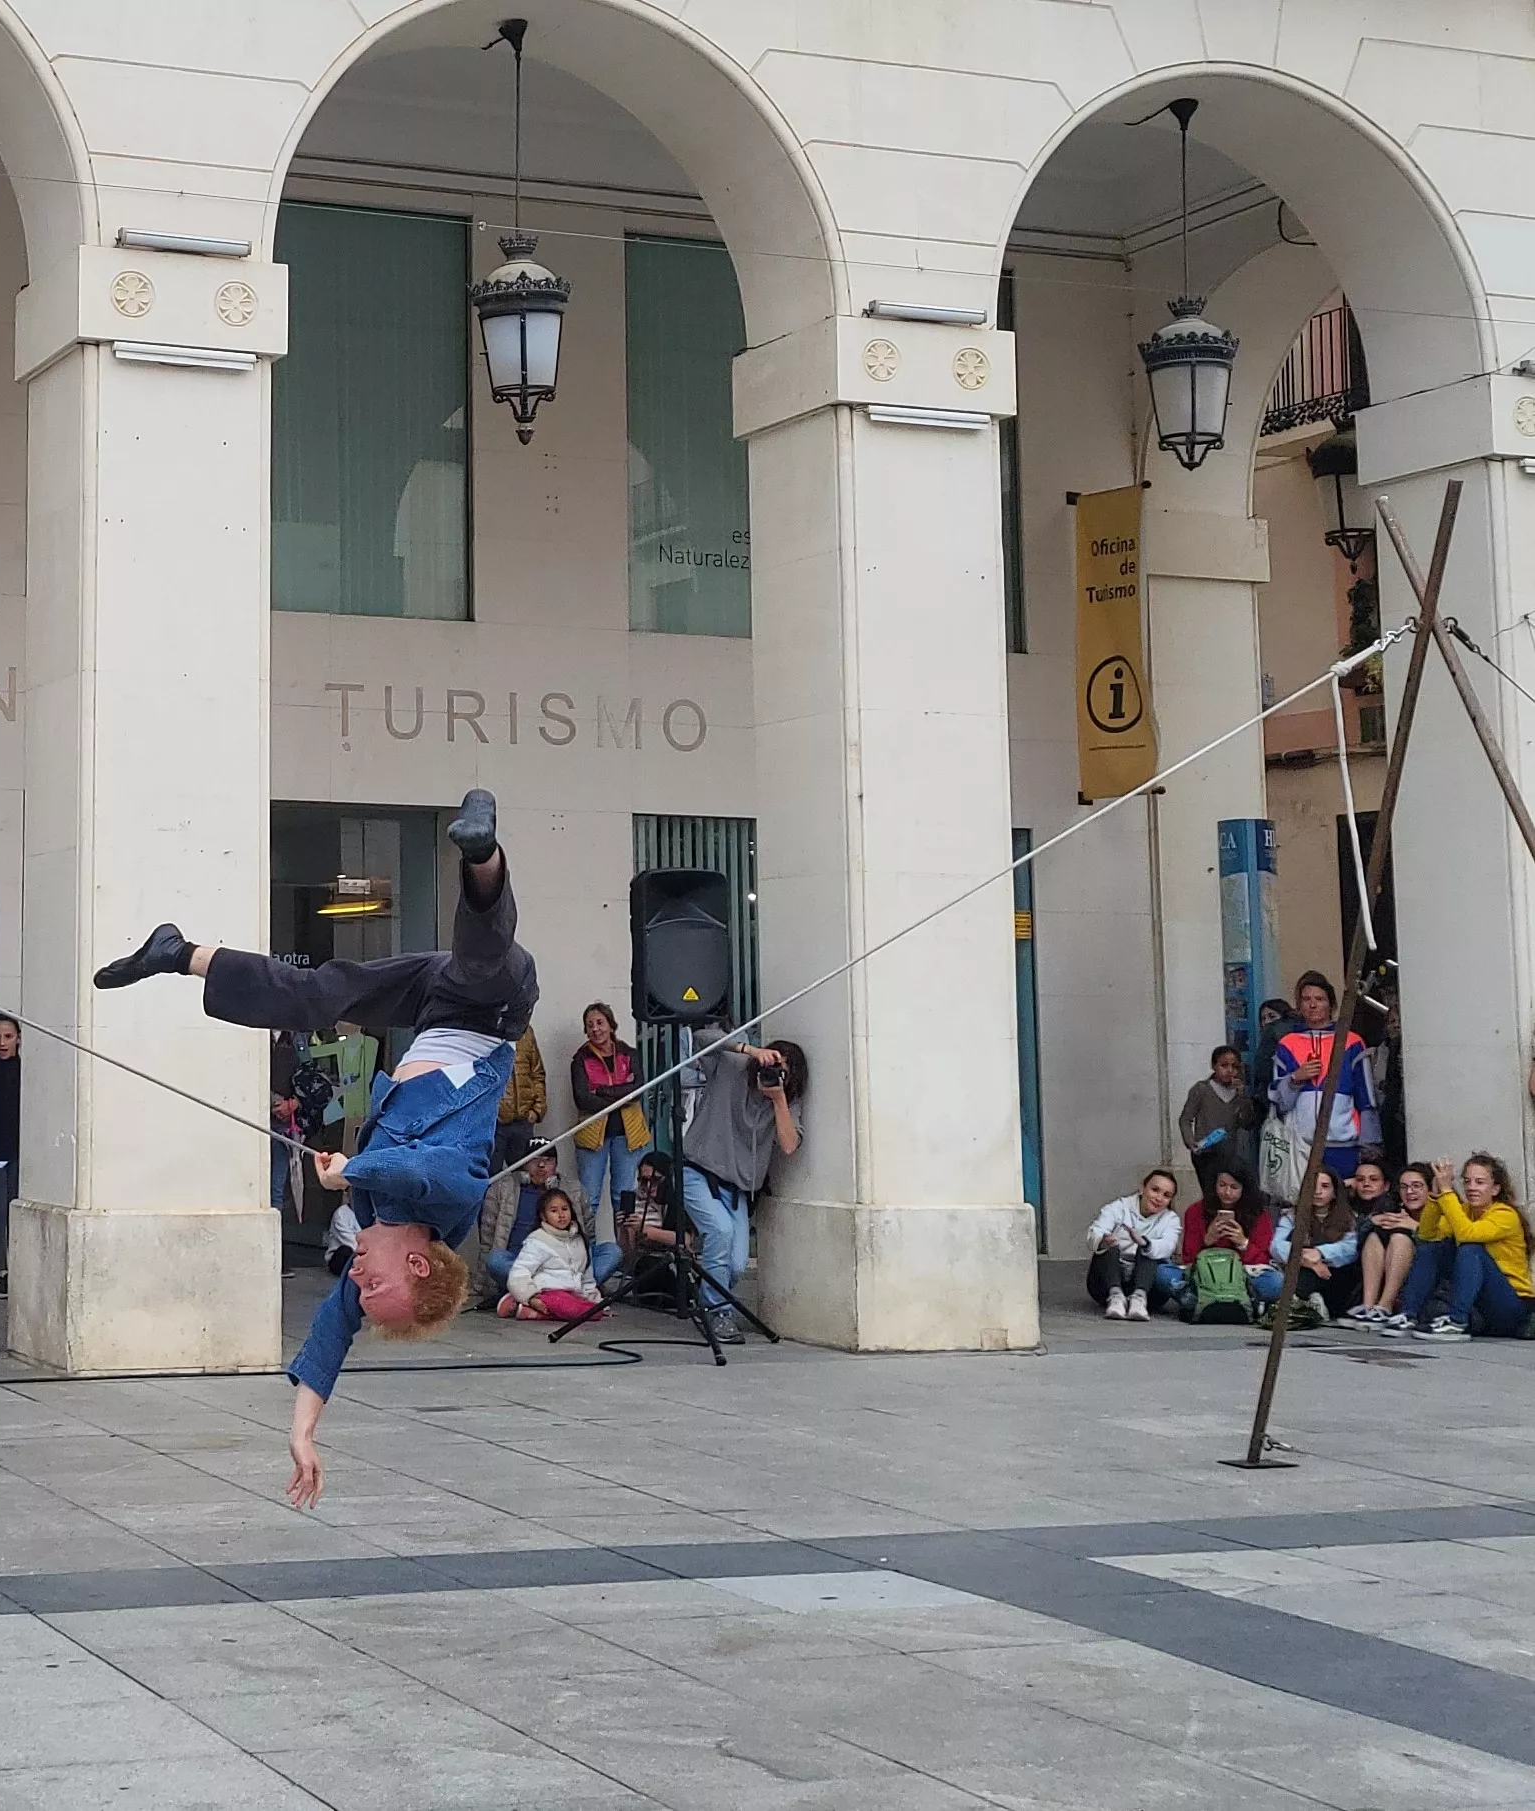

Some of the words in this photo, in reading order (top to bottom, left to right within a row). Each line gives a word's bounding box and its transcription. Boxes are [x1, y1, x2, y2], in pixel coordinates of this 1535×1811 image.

[659, 543, 750, 570] Naturalez
[1091, 536, 1135, 557] Oficina
[1119, 557, 1136, 575] de
[325, 682, 707, 752] TURISMO
